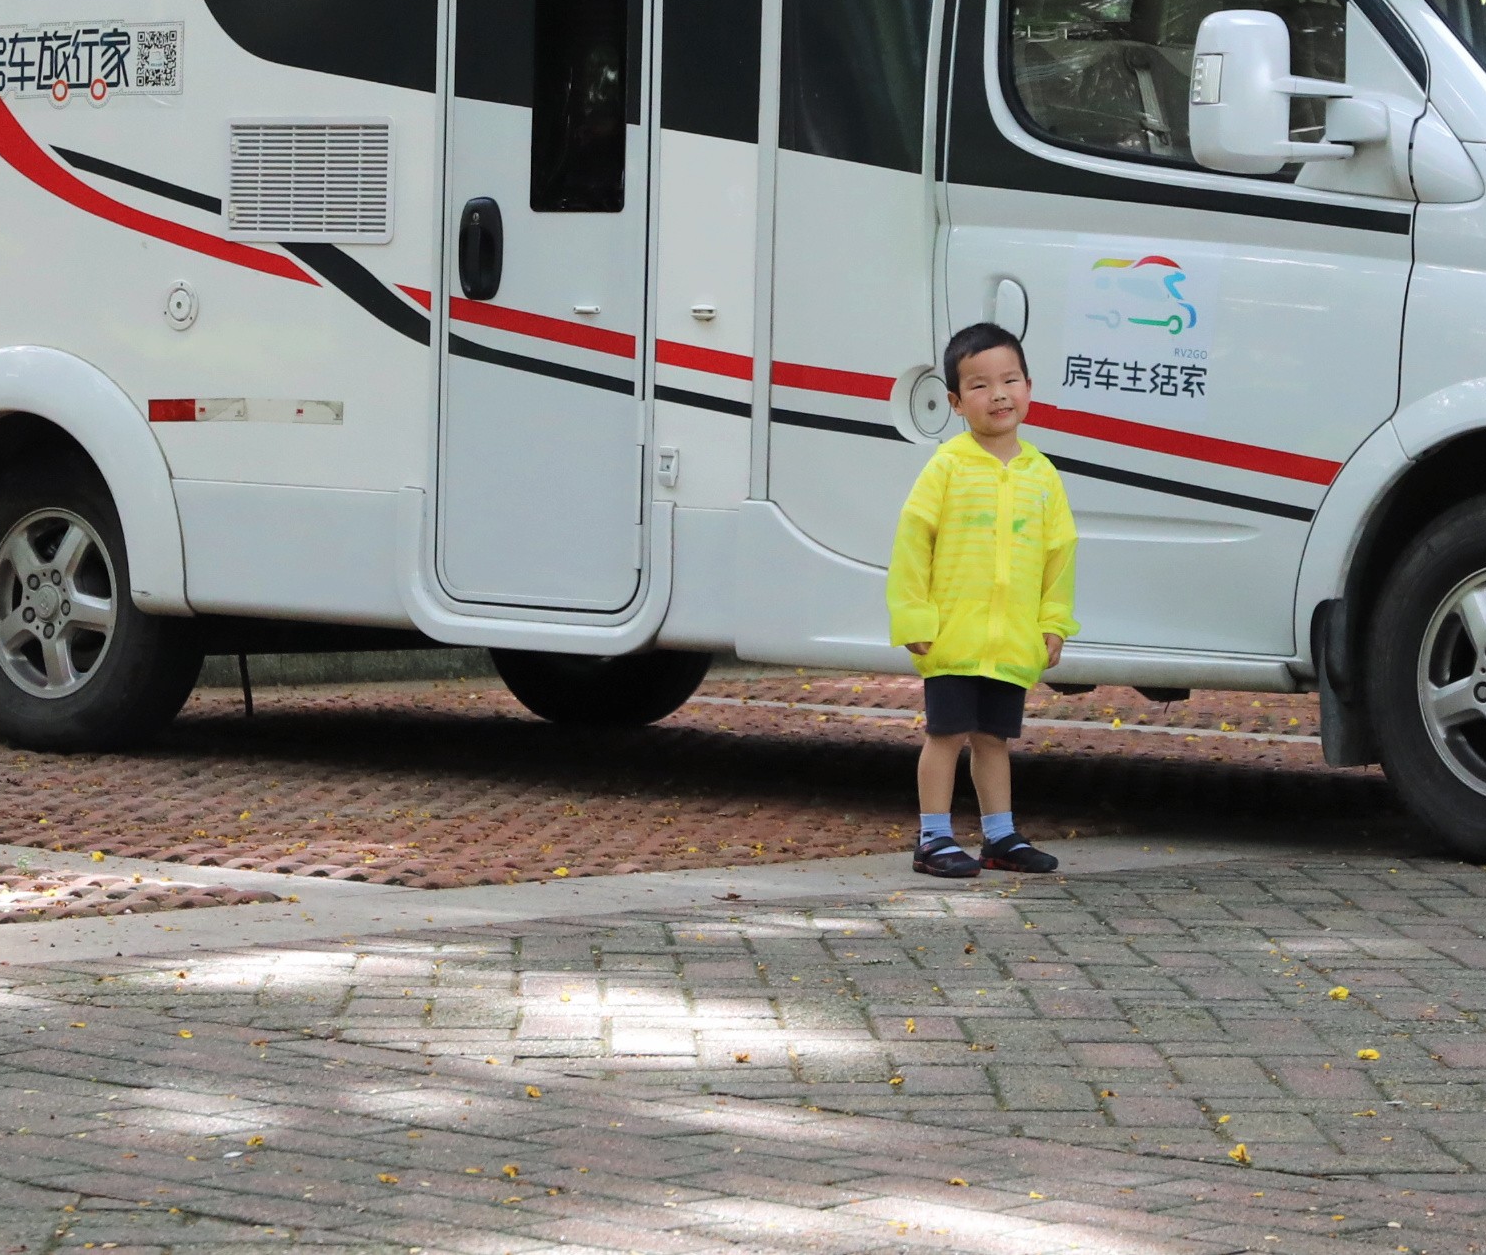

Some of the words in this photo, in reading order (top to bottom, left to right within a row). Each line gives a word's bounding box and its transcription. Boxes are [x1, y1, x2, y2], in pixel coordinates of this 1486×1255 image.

[1174, 347, 1208, 360] RV2GO
[1062, 354, 1208, 398] 房车生活家
